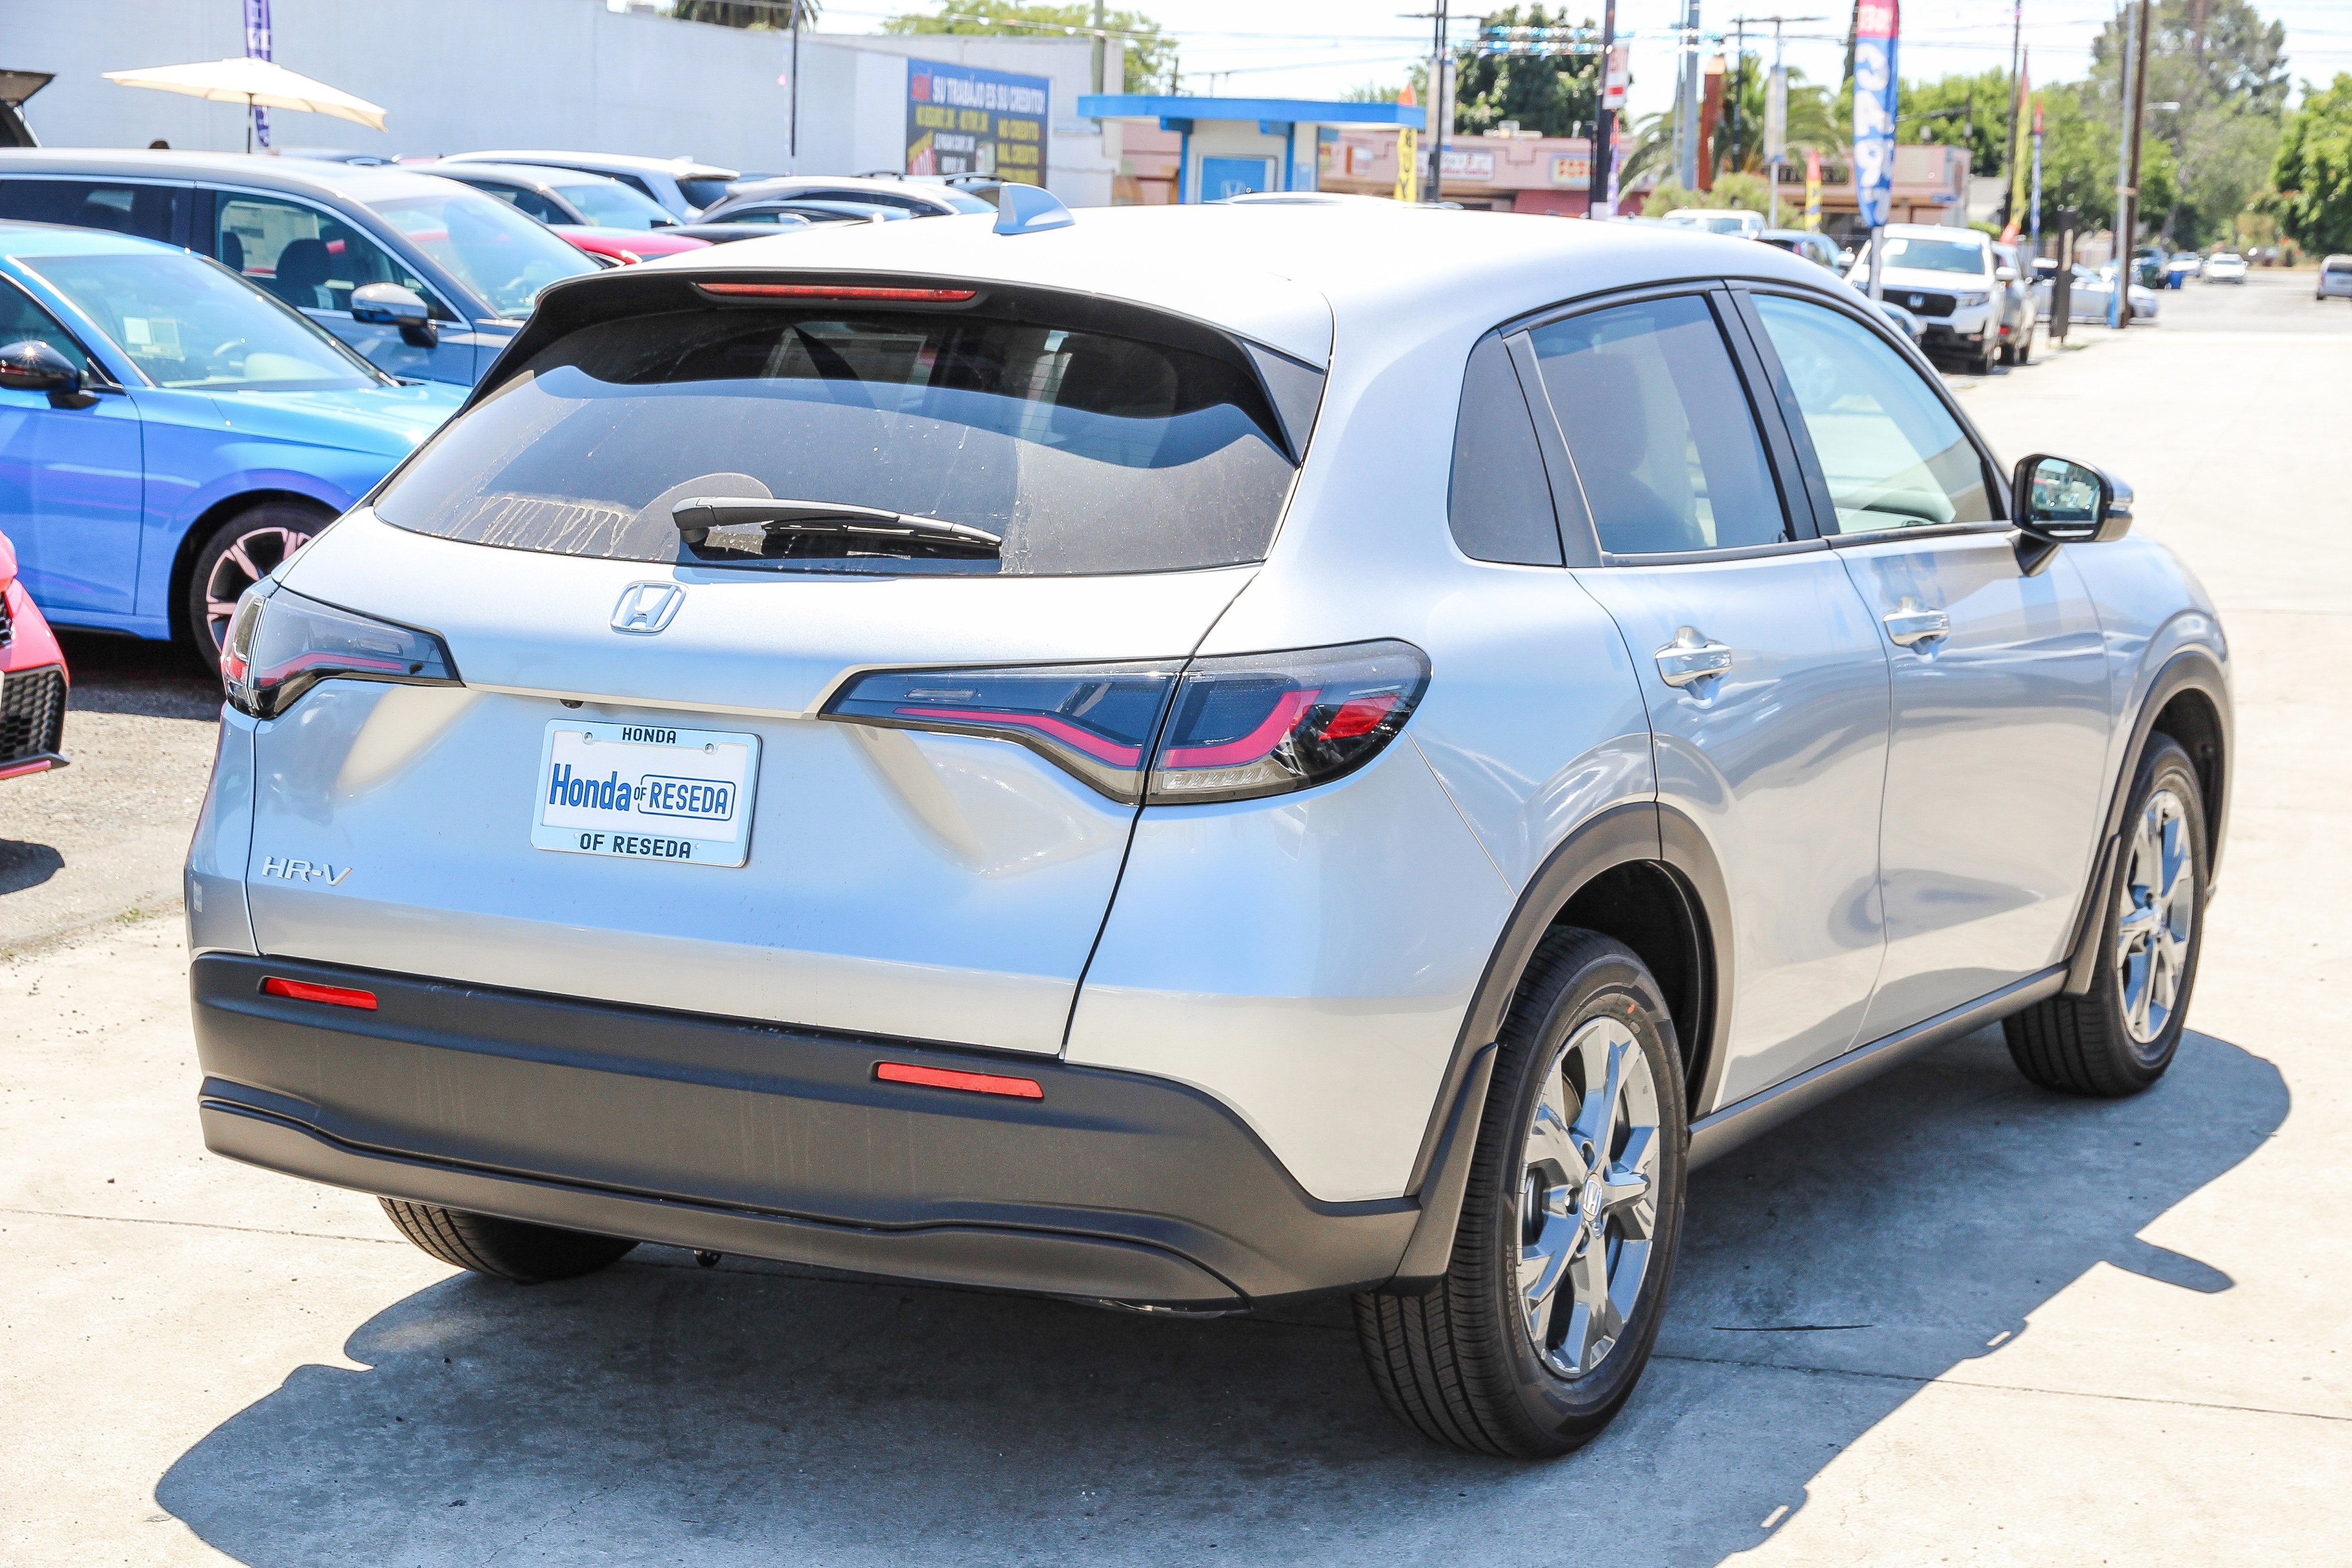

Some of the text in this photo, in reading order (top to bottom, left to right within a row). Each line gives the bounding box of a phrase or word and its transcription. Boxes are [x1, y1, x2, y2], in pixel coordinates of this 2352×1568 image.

[622, 727, 677, 744] HONDA
[549, 764, 729, 814] Honda OF RESEDA
[580, 833, 691, 859] OF RESEDA
[261, 855, 353, 886] HR-V
